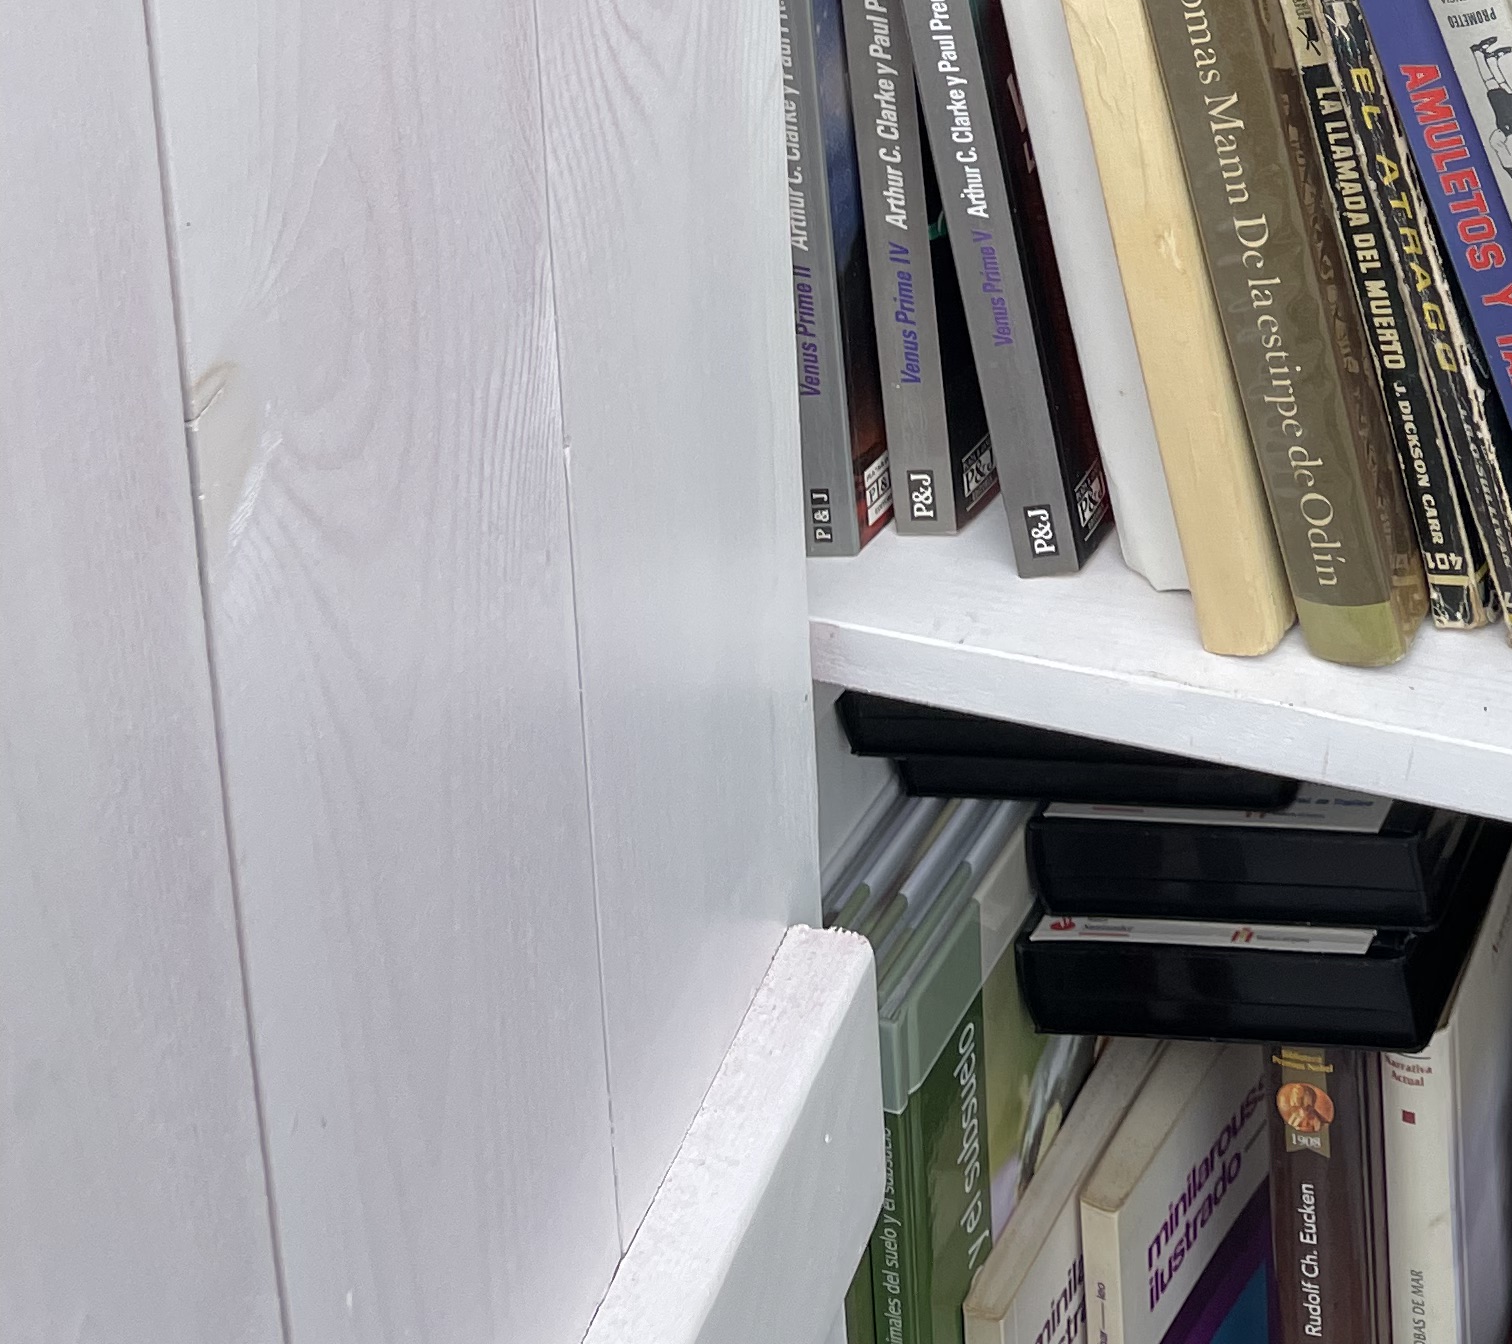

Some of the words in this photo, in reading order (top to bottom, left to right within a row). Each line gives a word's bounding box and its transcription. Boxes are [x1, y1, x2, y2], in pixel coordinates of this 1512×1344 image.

[866, 14, 892, 60] Paul
[1447, 7, 1498, 29] PROMETEO
[874, 76, 899, 142] Clarke
[1204, 92, 1250, 205] Mann
[1325, 121, 1371, 228] LLAMADA
[1399, 63, 1507, 272] AMULETOS
[882, 161, 908, 231] Arthur
[1352, 233, 1375, 274] DEL
[895, 269, 916, 325] Prime
[1363, 279, 1406, 370] MUERTO
[901, 330, 921, 385] Venus
[1257, 314, 1303, 437] estirpe
[1288, 445, 1323, 487] de
[1397, 400, 1431, 488] DICKSON
[910, 473, 934, 519] P&J
[1421, 493, 1445, 546] CARR
[1300, 493, 1345, 587] Odín
[953, 1022, 982, 1194] subsuelo
[1291, 1134, 1322, 1148] 1908
[961, 1189, 982, 1235] el
[1148, 1151, 1243, 1313] ilustrado
[1297, 1183, 1315, 1246] Eucken
[967, 1229, 989, 1270] y
[1301, 1241, 1321, 1276] Ch.
[1304, 1272, 1323, 1337] Rudolf
